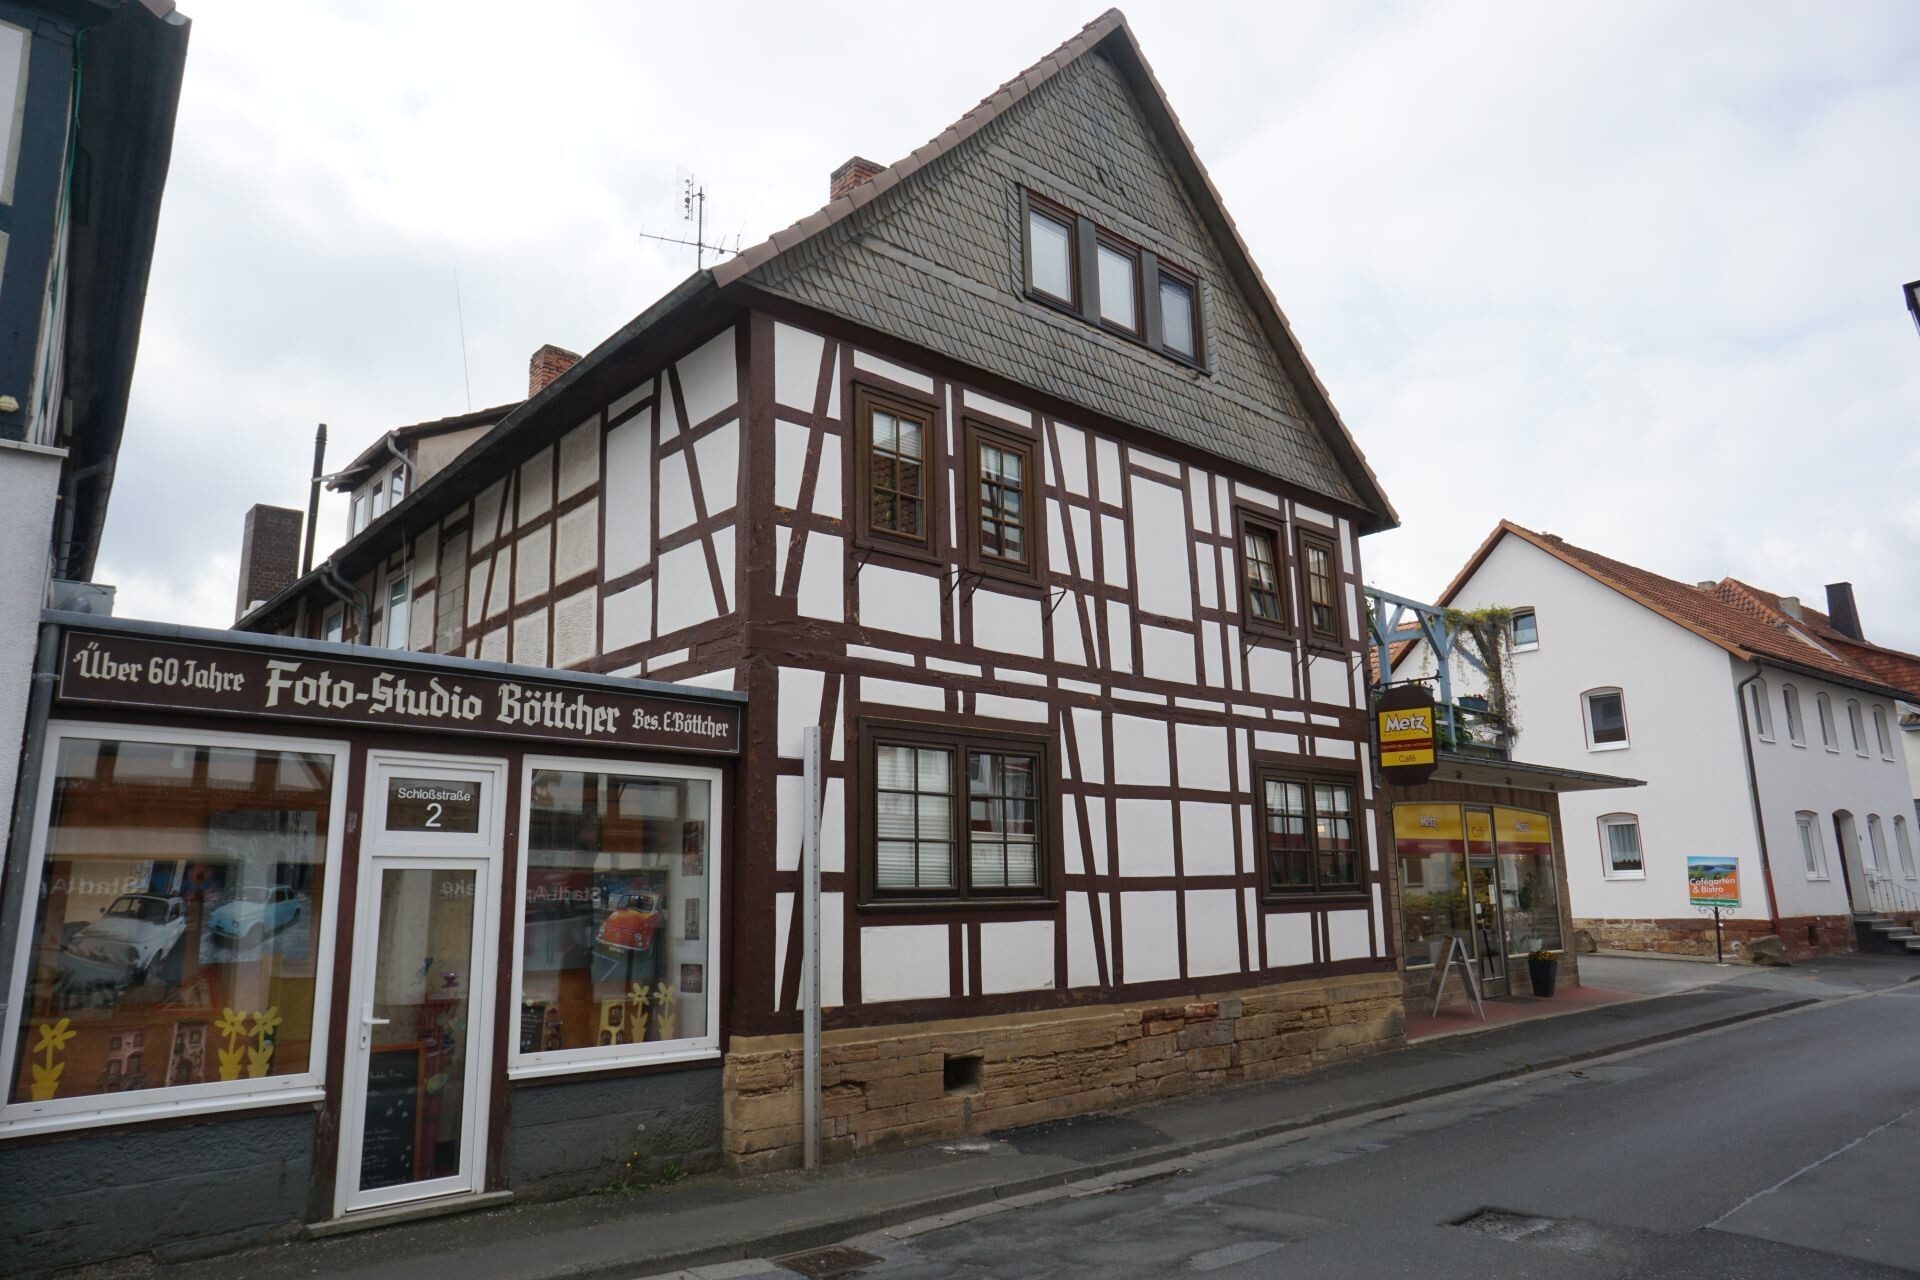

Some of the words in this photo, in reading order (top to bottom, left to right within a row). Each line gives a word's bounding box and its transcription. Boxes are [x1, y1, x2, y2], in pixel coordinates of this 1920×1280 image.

[73, 642, 143, 683] Über
[148, 656, 178, 686] 60
[181, 659, 245, 693] Jahre
[264, 659, 483, 720] Foto-Studio
[496, 683, 621, 736] Böttcher
[632, 708, 662, 731] Bes.
[1385, 715, 1428, 733] Metz
[397, 787, 471, 802] Schloßstraße
[424, 802, 442, 828] 2
[1690, 877, 1736, 886] Cafégarten
[1692, 885, 1699, 893] &
[1701, 885, 1724, 893] Bistro
